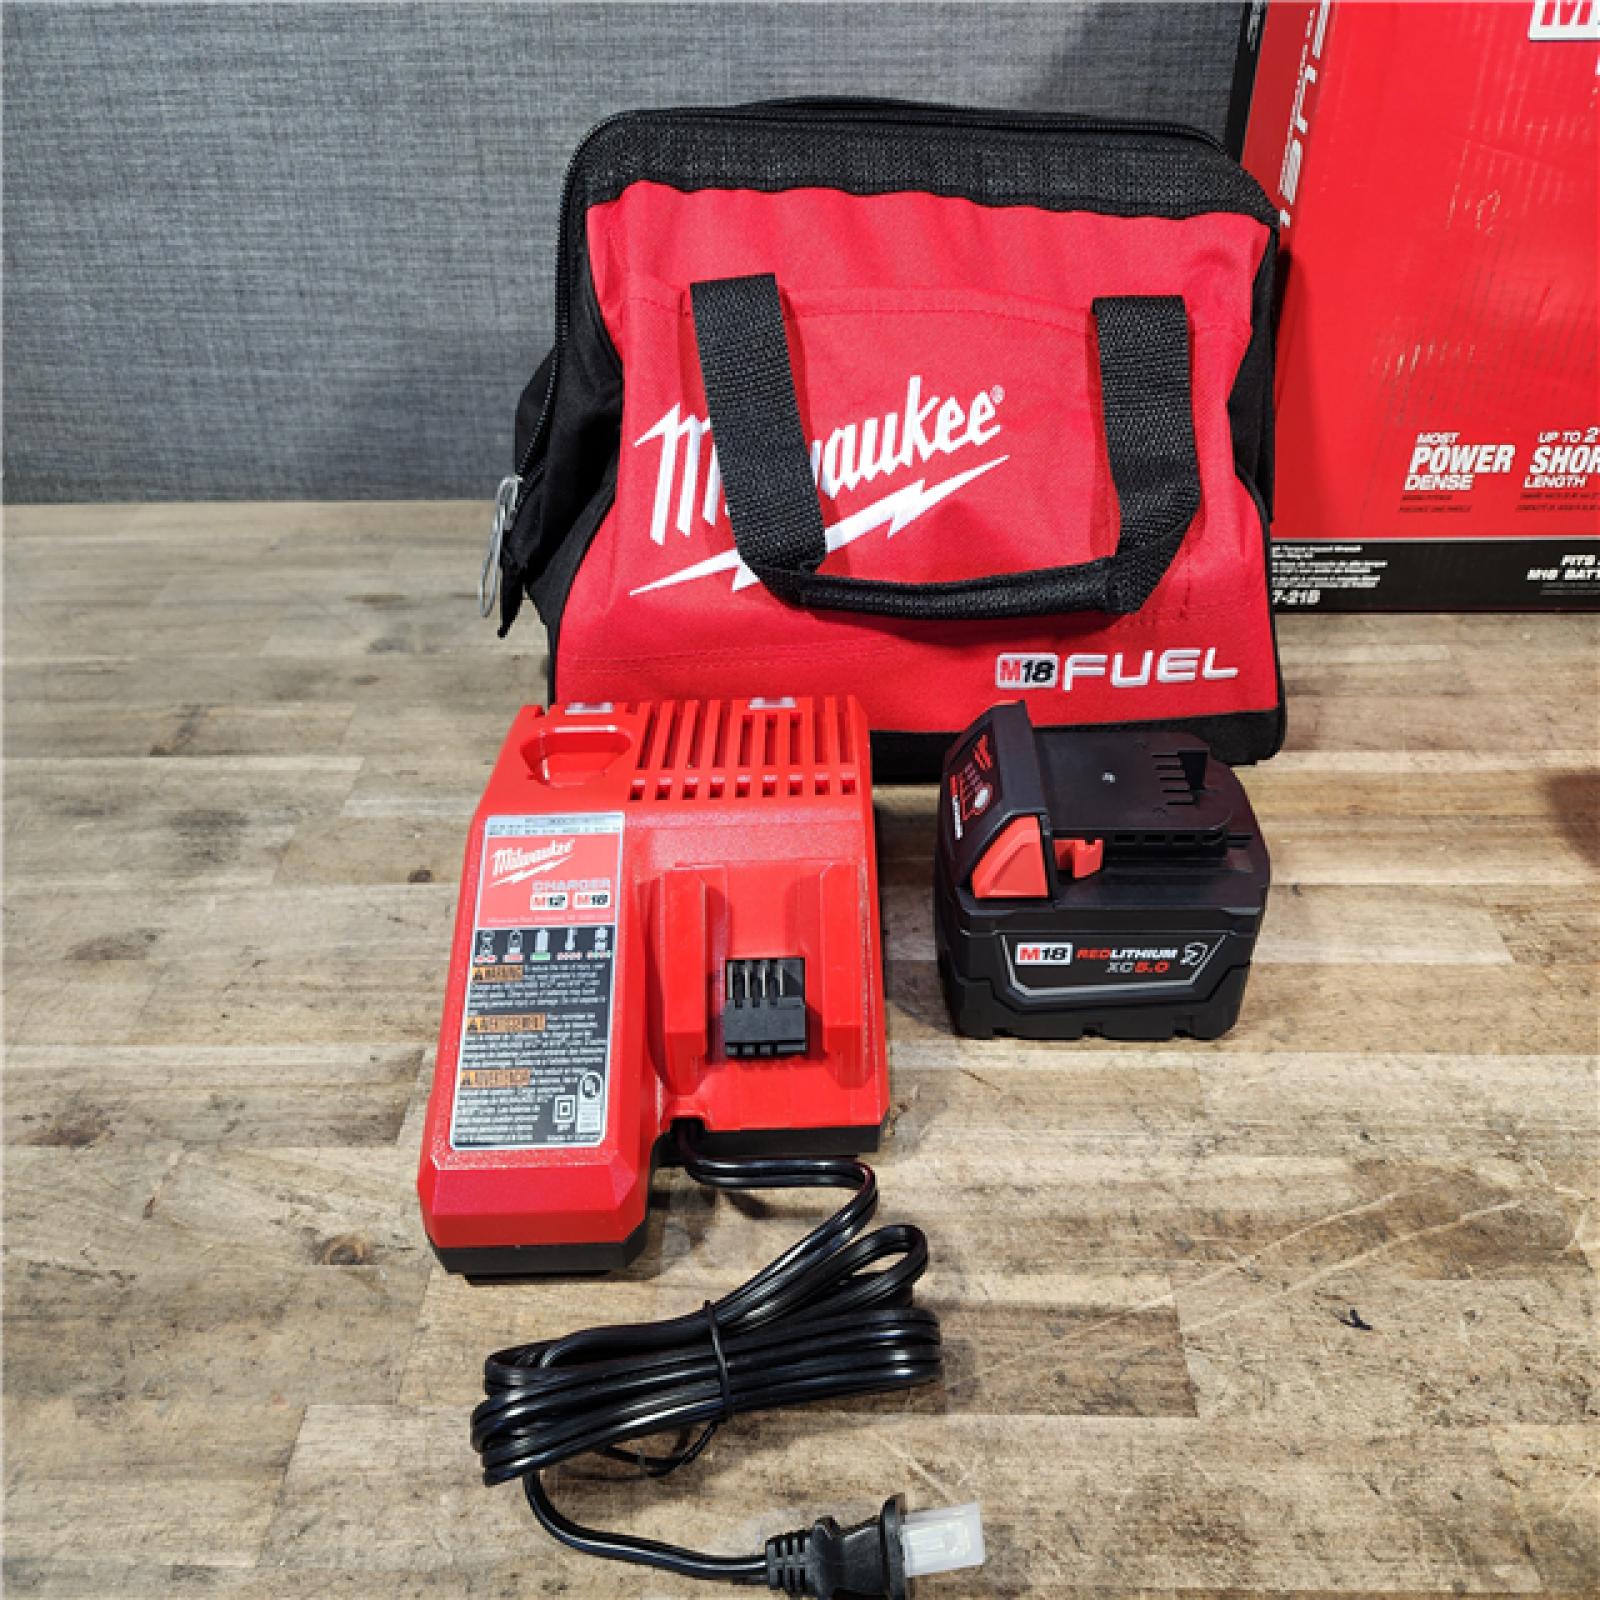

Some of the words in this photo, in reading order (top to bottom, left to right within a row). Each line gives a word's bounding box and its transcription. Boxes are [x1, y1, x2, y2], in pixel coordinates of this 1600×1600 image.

[1417, 432, 1460, 445] MOST
[1538, 432, 1559, 444] UP
[1562, 432, 1582, 444] TO
[1409, 445, 1516, 474] POWER
[1404, 475, 1475, 491] DENSE
[1524, 475, 1587, 489] LENGTH
[998, 656, 1057, 685] M18
[1062, 647, 1239, 692] FUEL
[491, 839, 573, 877] Milwaukee
[1017, 945, 1070, 962] M18
